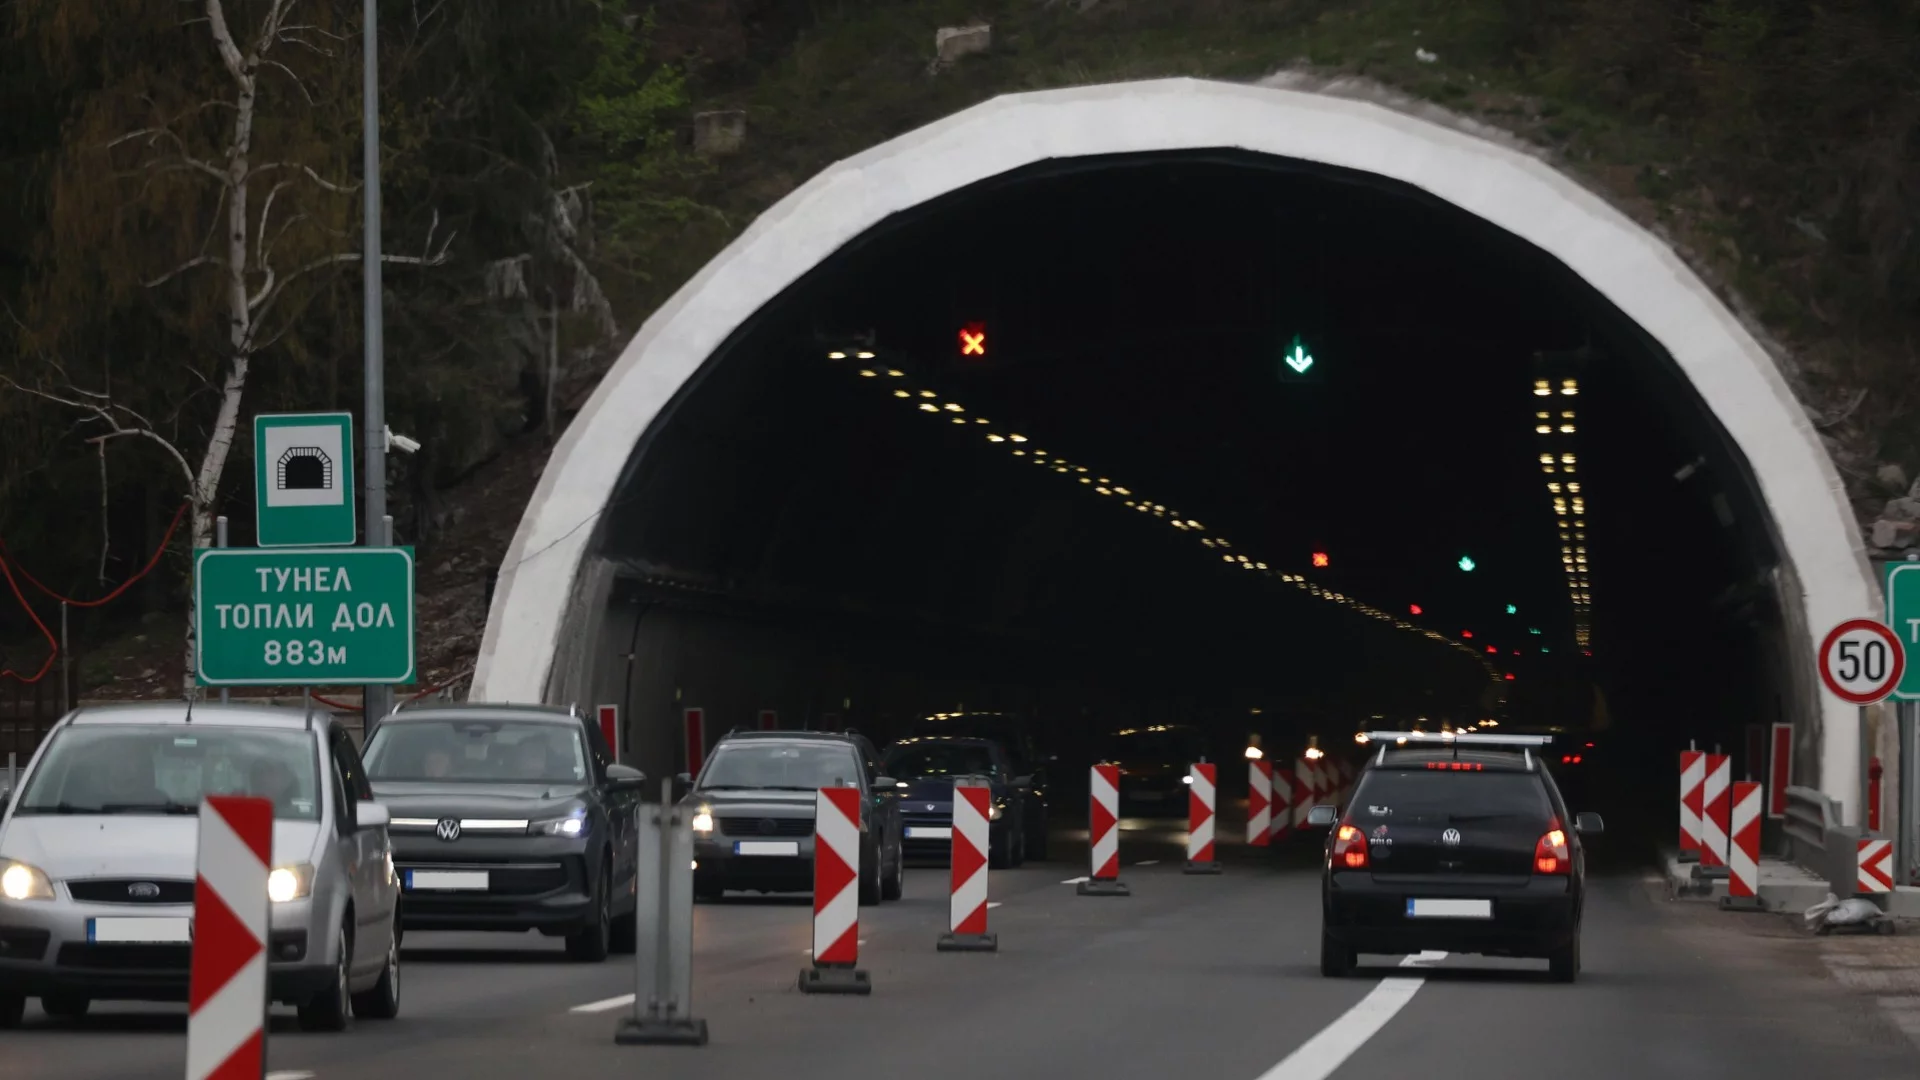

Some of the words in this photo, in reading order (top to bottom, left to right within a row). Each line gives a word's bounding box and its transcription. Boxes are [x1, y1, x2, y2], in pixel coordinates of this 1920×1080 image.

[256, 566, 352, 592] ТУНЕЛ
[215, 603, 314, 629] ТОПЛИ
[332, 602, 395, 631] ДОЛ
[264, 640, 347, 665] 883м
[1838, 640, 1886, 682] 50
